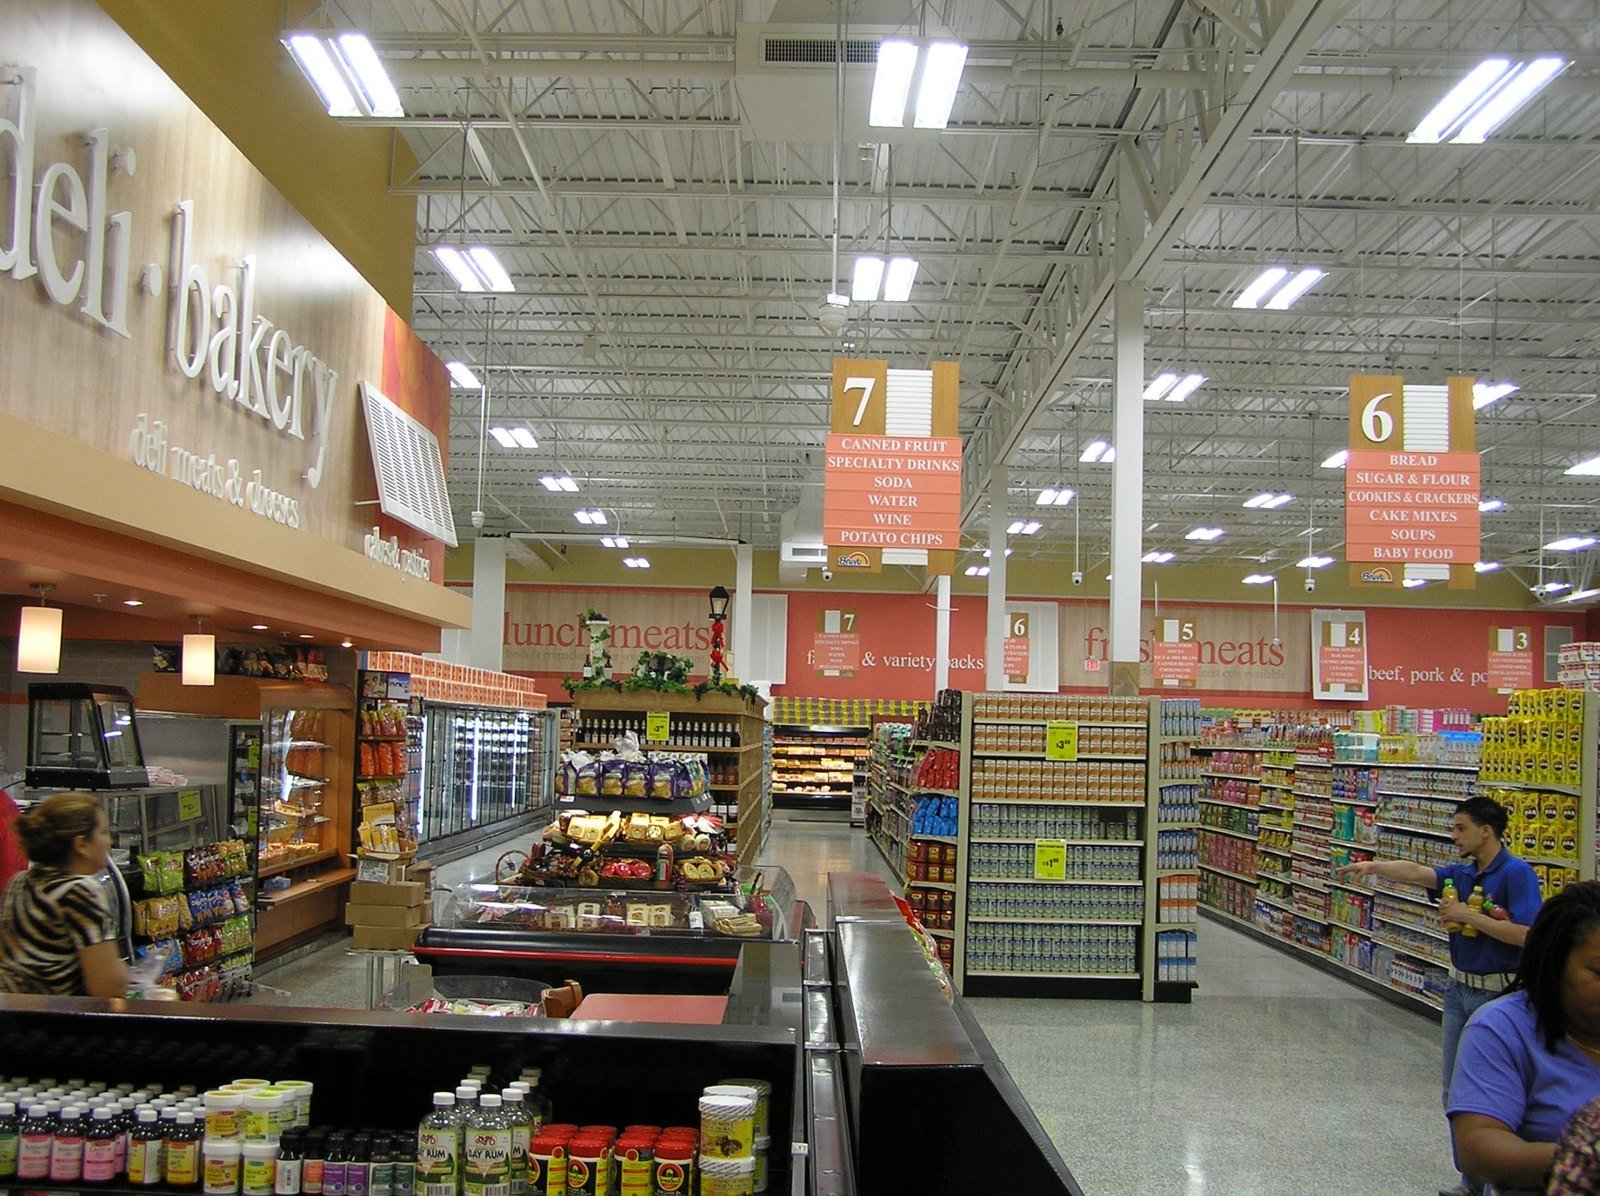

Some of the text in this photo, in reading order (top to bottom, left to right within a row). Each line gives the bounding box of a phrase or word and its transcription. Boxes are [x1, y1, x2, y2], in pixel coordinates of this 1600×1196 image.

[0, 65, 338, 489] deli bakery
[843, 377, 876, 426] 7
[1361, 392, 1393, 443] 6
[841, 438, 948, 452] CANNED FRUIT
[828, 456, 960, 471] SPECIALTY DRINKS
[1390, 454, 1438, 466] BREAD
[130, 412, 299, 530] deli meats & cheeses
[1356, 472, 1470, 485] SUGAR & FLOUR
[874, 476, 912, 488] SODA
[868, 494, 918, 507] WATER
[1348, 490, 1478, 504] COOKIES & CRACKERS
[873, 514, 912, 525] WINE
[1369, 510, 1457, 522] CAKE MIXES
[841, 531, 943, 544] POTATO CHIPS
[1391, 529, 1436, 540] SOUPS
[1373, 547, 1453, 559] BABY FOOD
[844, 614, 855, 631] 7
[1014, 618, 1025, 636] 6
[607, 620, 712, 650] meats
[1182, 623, 1193, 640] 5
[1349, 627, 1360, 644] 4
[1084, 627, 1285, 666] frs meats
[1516, 632, 1528, 650] 3
[862, 651, 984, 672] & variety acks
[1368, 664, 1404, 683] beef,
[1410, 666, 1444, 685] pork
[1450, 668, 1464, 682] &
[426, 1149, 446, 1158] RUM
[485, 1150, 504, 1159] RUM
